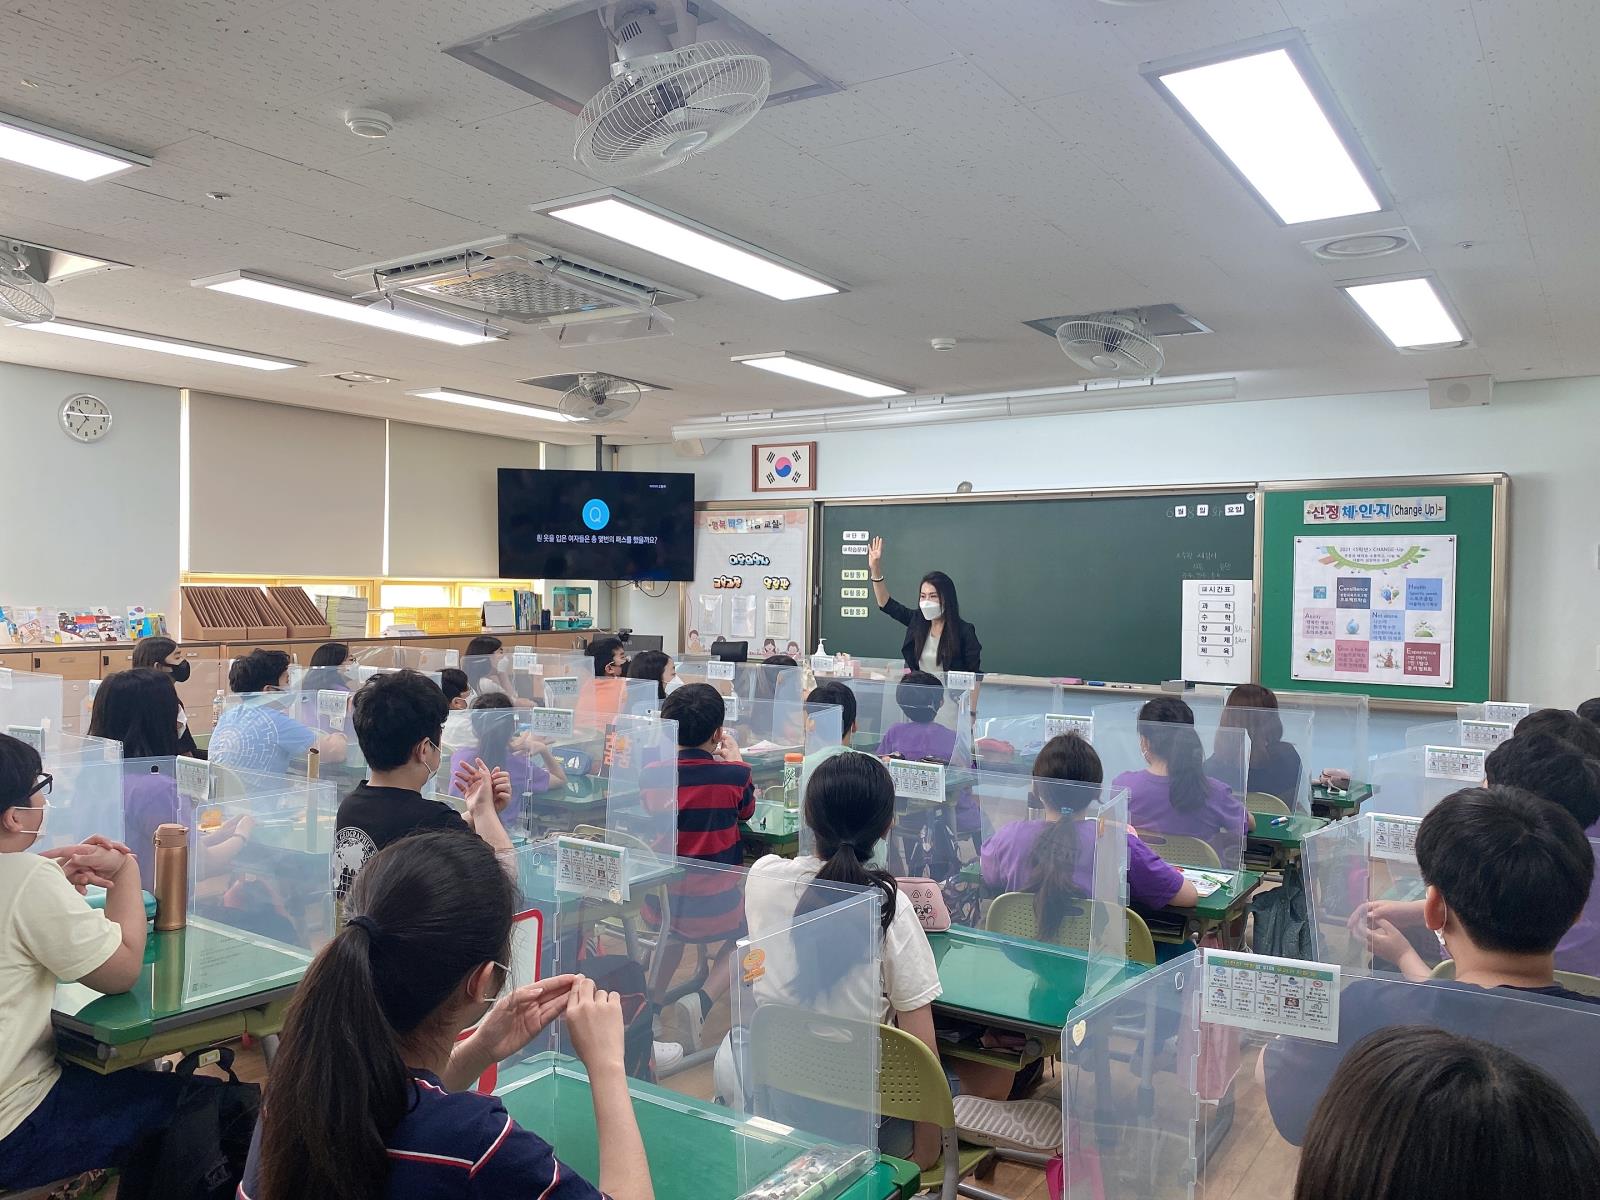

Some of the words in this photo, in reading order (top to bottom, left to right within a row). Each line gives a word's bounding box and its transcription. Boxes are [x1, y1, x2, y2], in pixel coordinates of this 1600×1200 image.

[589, 507, 601, 524] Q
[1199, 506, 1206, 514] 일
[1227, 505, 1242, 514] 요일
[1311, 505, 1339, 520] 신정
[1391, 503, 1422, 519] (Change
[1424, 503, 1438, 518] Up)
[764, 520, 779, 529] 교실
[536, 534, 543, 543] 흰
[543, 534, 555, 543] 옷을
[556, 535, 567, 543] 입은
[567, 535, 590, 543] 여자들은
[591, 535, 597, 544] 총
[616, 536, 632, 544] 패스를
[339, 830, 372, 848] GEOGRAPHIC
